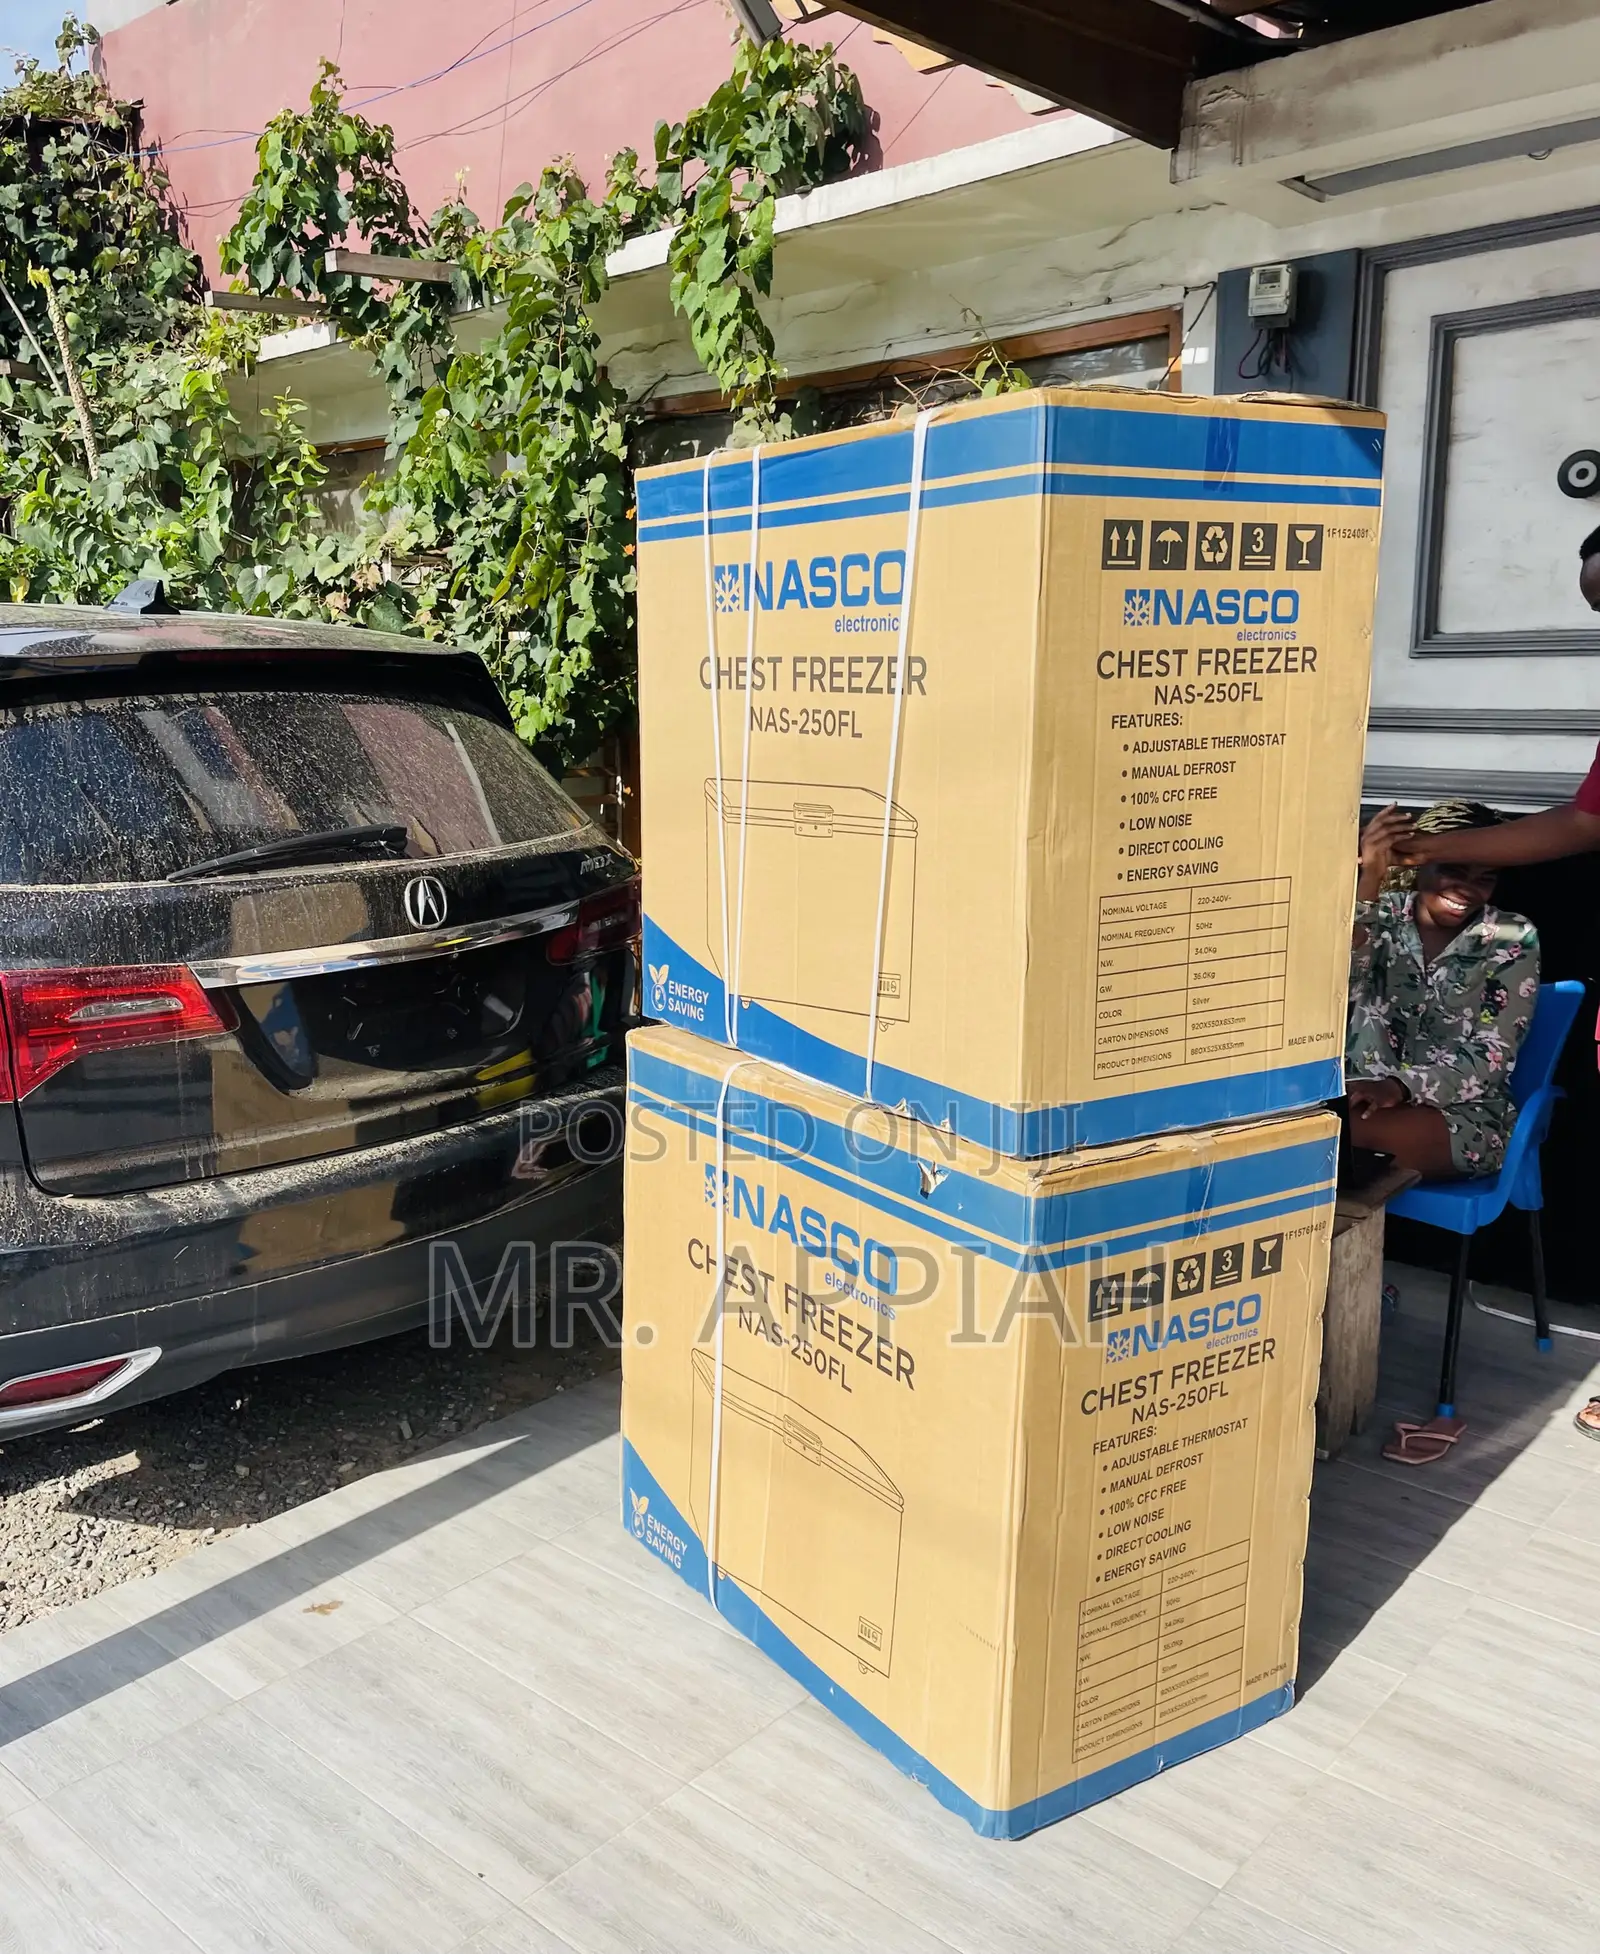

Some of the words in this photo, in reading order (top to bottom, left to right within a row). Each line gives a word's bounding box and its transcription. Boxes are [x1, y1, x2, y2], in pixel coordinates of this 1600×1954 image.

[743, 549, 906, 611] NASCO
[1153, 589, 1299, 625] NASCO
[835, 613, 899, 632] electronic
[1237, 628, 1296, 641] electronics
[700, 656, 782, 691] CHEST
[792, 656, 927, 696] FREEZER
[1097, 649, 1188, 679] CHEST
[1197, 646, 1317, 676] FREEZER
[1155, 682, 1263, 705] NAS-250FL
[750, 706, 862, 738] NAS-250FL
[1111, 712, 1183, 729] FEATURES:
[1133, 738, 1208, 754] ADJUSTABLE
[1211, 733, 1286, 749] THERMOSTAT
[1131, 764, 1180, 779] MANUAL
[1183, 761, 1236, 776] DEFROST
[1131, 791, 1159, 805] 100%
[1162, 789, 1185, 803] CFC
[1188, 787, 1218, 801] FREE
[1130, 817, 1155, 831] LOW
[1158, 814, 1192, 829] NOISE
[1128, 841, 1169, 856] DIRECT
[1172, 836, 1224, 852] COOLING
[580, 853, 615, 875] MDX
[1127, 866, 1173, 882] ENERGY
[1176, 861, 1219, 877] SAVING
[1102, 905, 1134, 916] NOMINAL
[1136, 902, 1167, 913] VOLTAGE
[1101, 932, 1133, 943] NOMINAL
[1134, 926, 1175, 938] FREQUENCY
[668, 980, 709, 1006] ENERGY
[668, 997, 704, 1022] SAVING
[1098, 1009, 1122, 1019] COLOR
[1098, 1034, 1126, 1046] CARTON
[1128, 1027, 1169, 1040] DIMENSIONS
[1288, 1036, 1306, 1046] MADE
[1308, 1035, 1314, 1043] IN
[1315, 1031, 1334, 1042] CHINA
[1097, 1059, 1129, 1071] PRODUCT
[1131, 1052, 1172, 1065] DIMENSIONS
[733, 1175, 898, 1296] NASCO
[825, 1272, 896, 1321] electronics
[688, 1238, 774, 1304] CHEST
[784, 1282, 914, 1391] FREEZER
[1132, 1294, 1261, 1357] NASCO
[739, 1306, 852, 1393] NAS-250FL
[1206, 1328, 1258, 1350] electronics
[1081, 1371, 1163, 1415] CHEST
[1171, 1338, 1275, 1389] FREEZER
[1132, 1381, 1229, 1424] NAS-250FL
[1093, 1426, 1157, 1455] FEATURES:
[1111, 1440, 1179, 1471] ADJUSTABLE
[1182, 1418, 1248, 1447] THERMOSTAT
[1110, 1472, 1153, 1494] MANUAL
[1156, 1453, 1204, 1477] DEFROST
[1109, 1497, 1135, 1515] 100%
[1137, 1490, 1158, 1505] CFC
[1160, 1479, 1187, 1498] FREE
[647, 1513, 688, 1556] ENERGY
[1107, 1520, 1131, 1538] LOW
[1134, 1508, 1165, 1528] NOISE
[646, 1530, 682, 1569] SAVING
[1105, 1537, 1143, 1560] DIRECT
[1145, 1519, 1192, 1545] COOLING
[1104, 1558, 1146, 1582] ENERGY
[1149, 1542, 1187, 1565] SAVING
